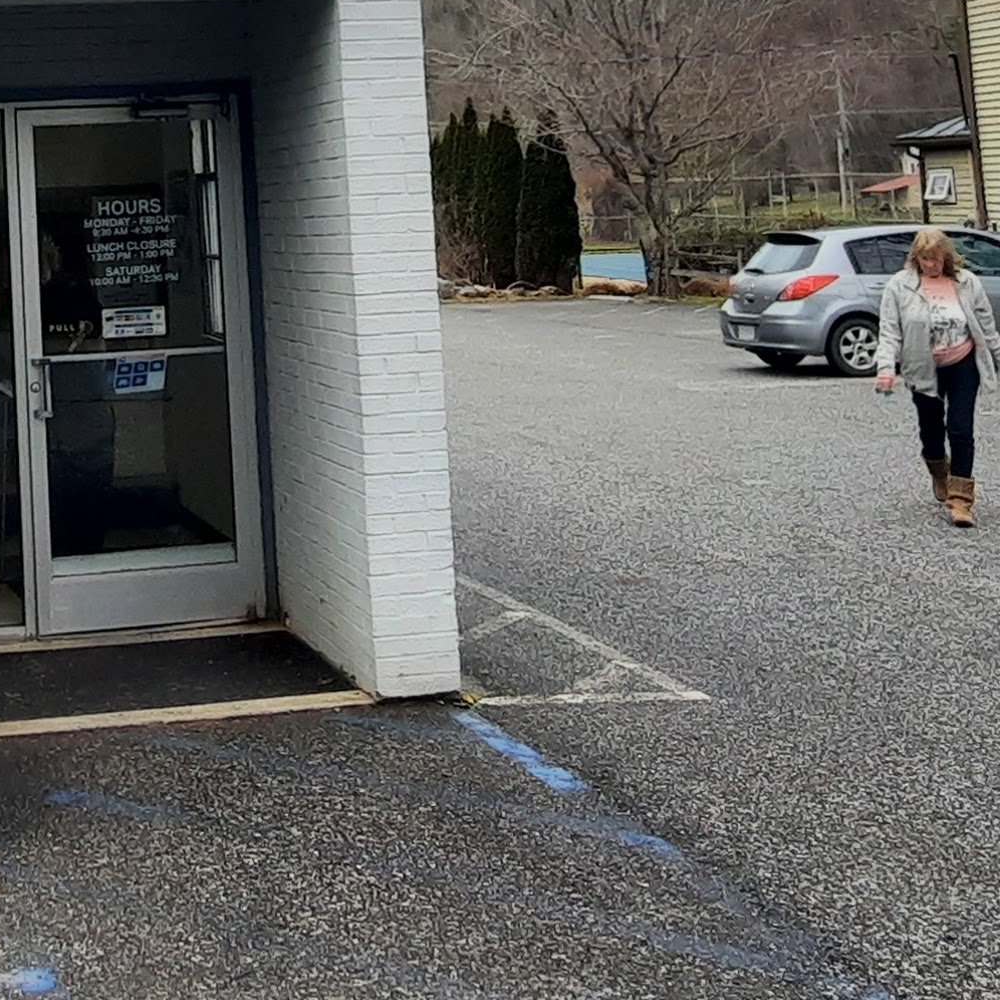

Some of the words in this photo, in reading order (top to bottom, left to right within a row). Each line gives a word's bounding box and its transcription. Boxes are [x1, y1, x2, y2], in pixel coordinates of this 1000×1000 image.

[97, 198, 162, 216] HOURS
[83, 217, 131, 229] MONDAY
[139, 215, 177, 226] FRIDAY
[113, 227, 129, 236] AM
[154, 225, 170, 234] PM
[86, 242, 125, 253] LUNCH
[126, 238, 177, 251] CLOSURE
[116, 251, 131, 260] PM
[159, 248, 175, 257] PM
[105, 264, 162, 277] SATURDAY
[115, 275, 131, 285] AM
[164, 272, 180, 281] PM
[48, 323, 76, 333] PULL
